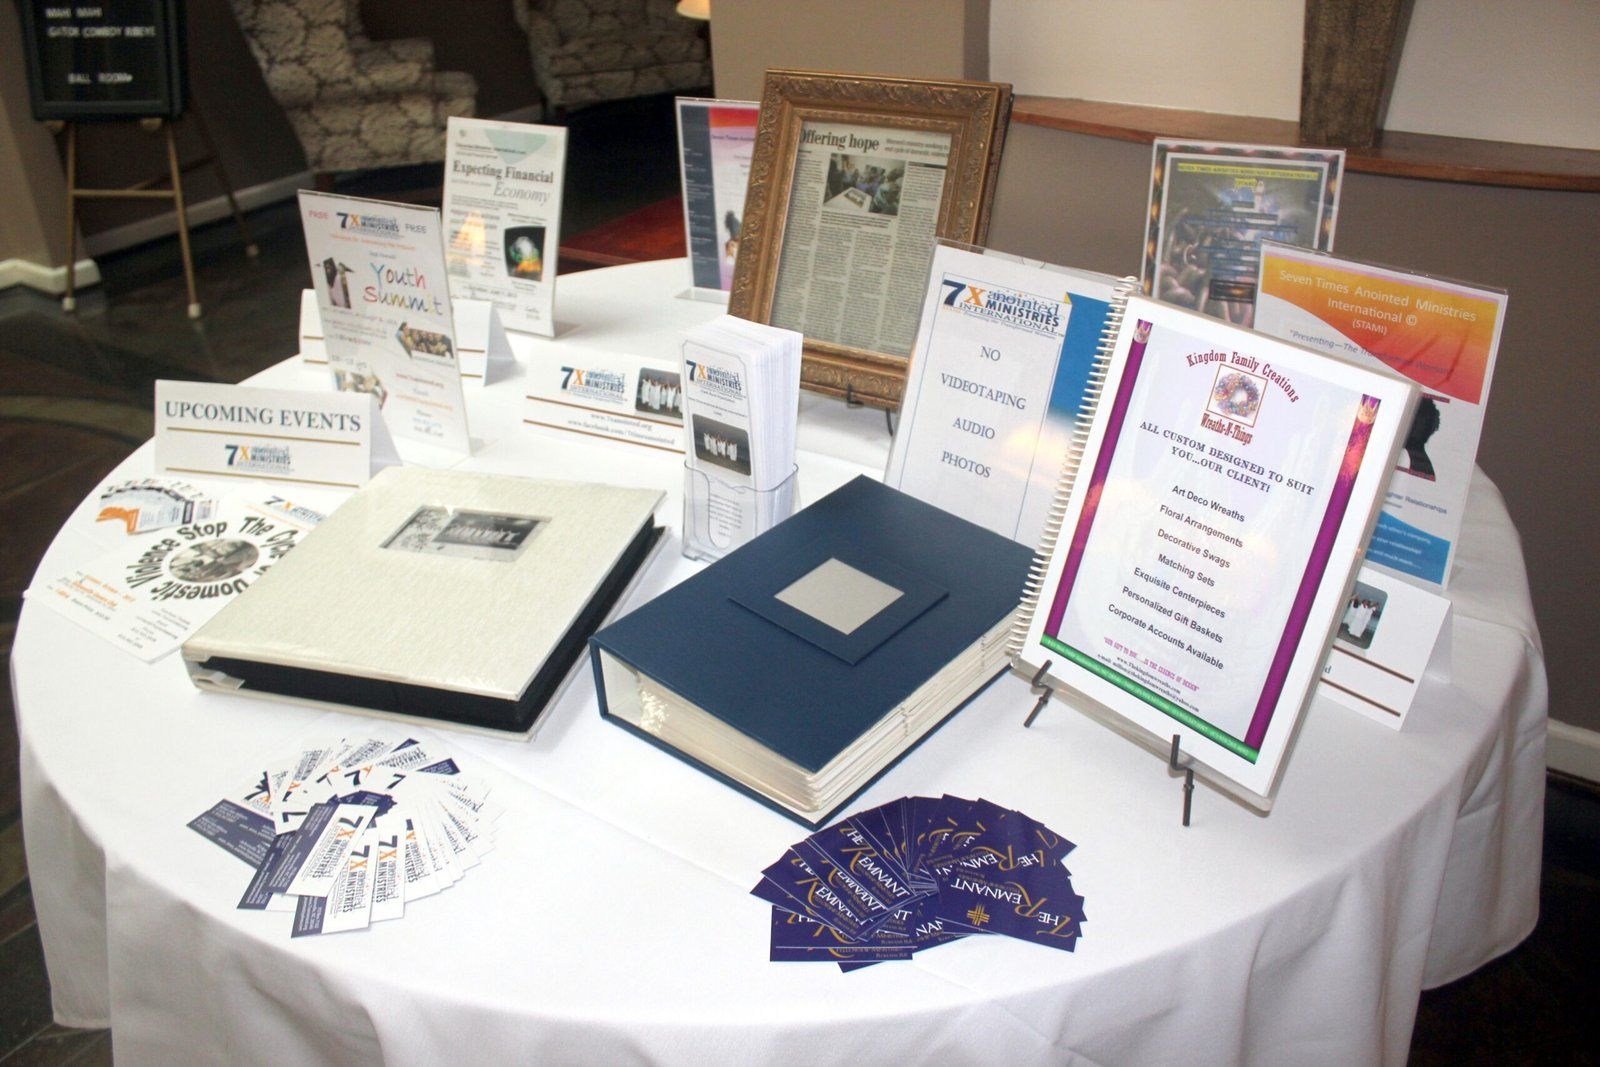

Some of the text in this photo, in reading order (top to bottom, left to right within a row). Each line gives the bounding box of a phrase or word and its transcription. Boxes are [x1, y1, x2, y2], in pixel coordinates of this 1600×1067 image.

[850, 133, 879, 153] hope
[453, 160, 554, 184] Expecting Financial
[494, 181, 550, 206] Economy
[370, 262, 426, 290] Youth
[363, 286, 443, 315] Summit
[942, 279, 987, 307] 7X
[1279, 269, 1477, 322] Seven Times Anointed Ministries
[958, 302, 1058, 334] INTERNATIONAL
[985, 300, 1060, 328] MINISTRIES
[1328, 297, 1402, 324] International
[1352, 318, 1388, 336] (STAMI)
[980, 346, 1001, 362] NO
[1343, 343, 1359, 355] The
[561, 366, 585, 390] 7X
[686, 359, 707, 381] 7X
[707, 374, 742, 391] MINISTRIES
[1186, 350, 1300, 403] Kingdom Family Creations
[585, 379, 625, 394] MINISTRIES
[941, 372, 1026, 410] VIDEOTAPING
[165, 400, 361, 432] UPCOMING EVENTS
[953, 417, 996, 440] AUDIO
[1200, 413, 1253, 446] Wreaths-N-Things
[225, 444, 250, 466] 7X
[942, 451, 992, 479] PHOTOS
[1140, 421, 1315, 496] ALL CUSTOM DESIGNED TO SUIT
[1227, 469, 1271, 493] CLIENT!
[1172, 485, 1245, 523] Art Deco Wreaths
[177, 521, 227, 540] Stop
[239, 517, 275, 536] The
[1160, 504, 1244, 549] Floral Arrangements
[1158, 528, 1231, 569] Decorative Swags
[1158, 553, 1215, 587] Matching Sets
[1134, 567, 1226, 619] Exquisite Centerpieces
[1122, 585, 1223, 644] Personalized Gift Baskets
[1108, 604, 1224, 670] Corporate Accounts Available
[312, 839, 341, 879] MINISTRIES
[350, 845, 370, 871] 7X
[378, 835, 398, 862] 7X
[343, 871, 358, 913] MINISTRIES
[376, 861, 387, 903] MINISTRIES
[951, 878, 1048, 918] REMNANT
[1035, 911, 1075, 938] THE
